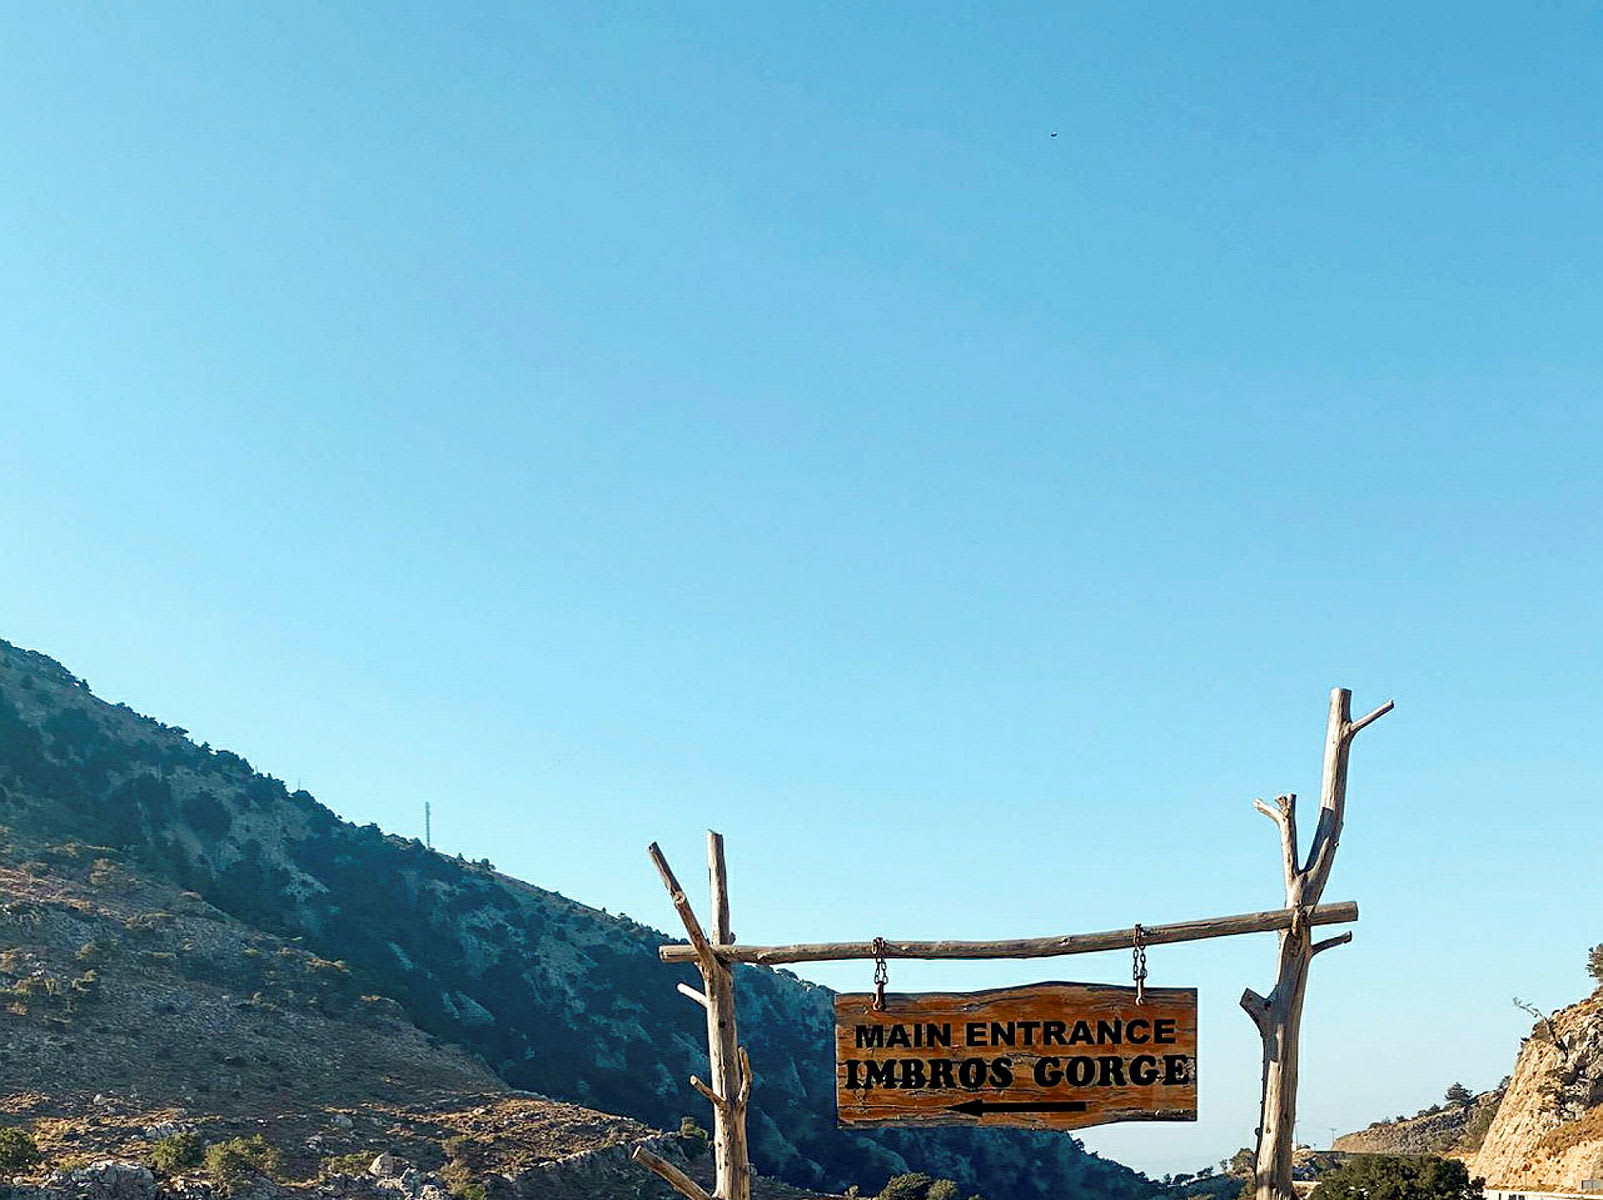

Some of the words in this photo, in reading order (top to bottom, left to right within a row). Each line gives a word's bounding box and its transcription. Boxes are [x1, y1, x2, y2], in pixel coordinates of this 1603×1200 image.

[855, 1023, 952, 1049] MAIN
[966, 1018, 1176, 1047] ENTRANCE
[844, 1057, 1014, 1090] IMBROS
[1033, 1054, 1190, 1089] GORGE
